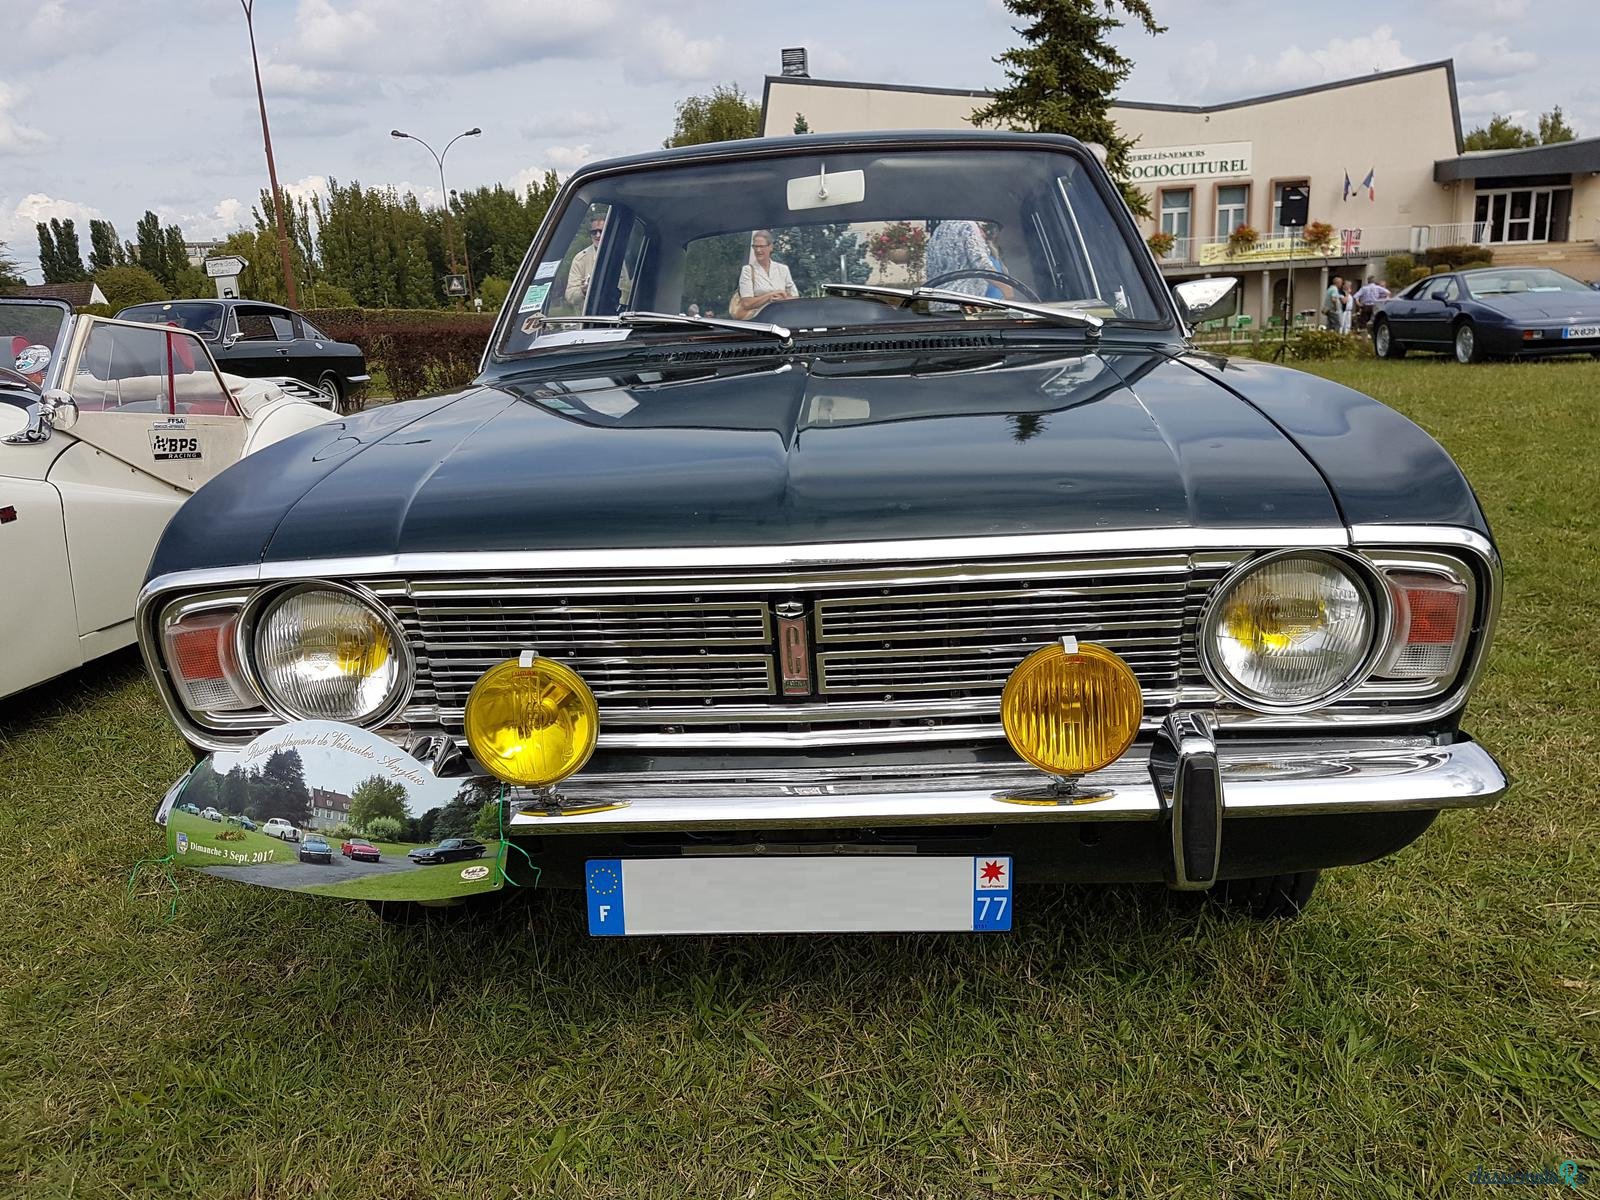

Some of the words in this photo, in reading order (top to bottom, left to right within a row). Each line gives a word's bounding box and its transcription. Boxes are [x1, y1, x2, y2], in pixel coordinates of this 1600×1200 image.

[168, 438, 198, 452] BPS
[316, 732, 329, 747] de
[376, 754, 426, 787] Anglais
[190, 842, 222, 857] Dimanche
[223, 849, 228, 859] 3
[229, 850, 250, 864] Sept.
[252, 849, 274, 863] 2017
[599, 905, 611, 922] F
[977, 897, 1008, 921] 77
